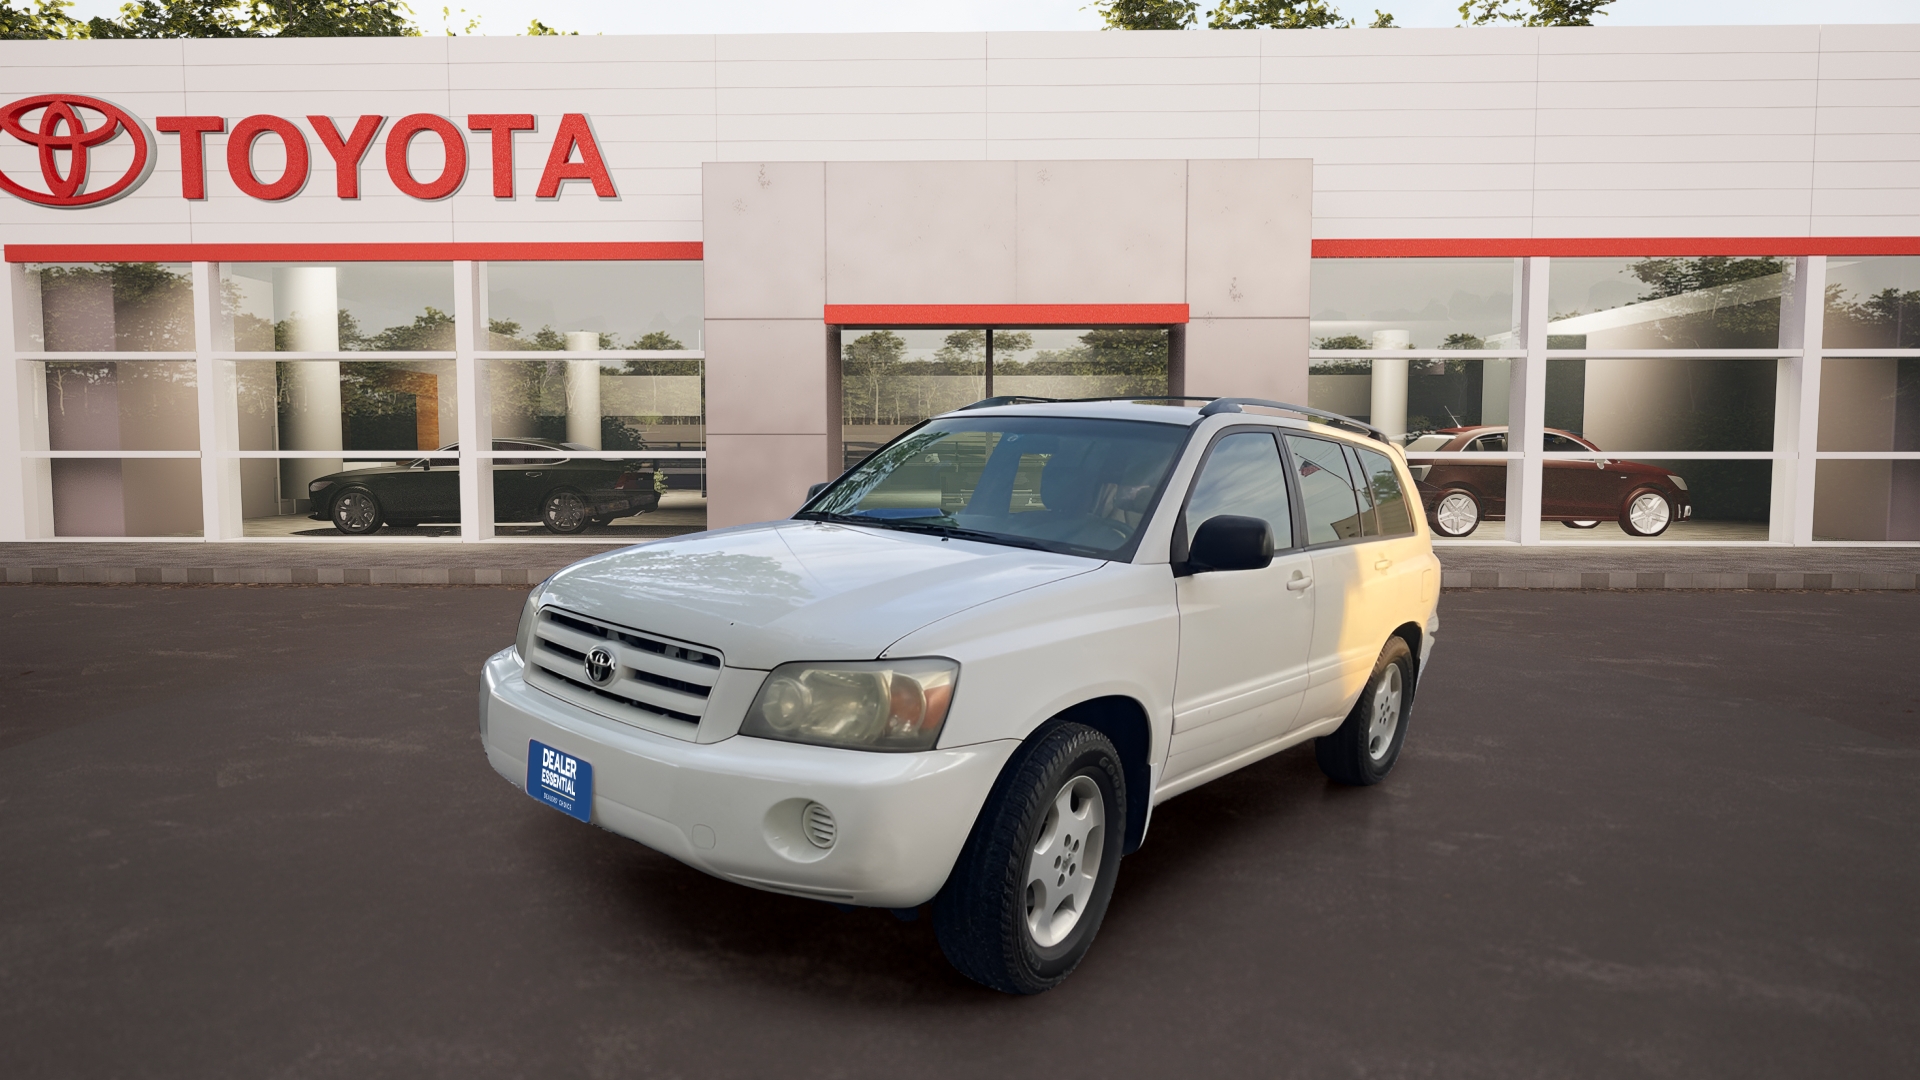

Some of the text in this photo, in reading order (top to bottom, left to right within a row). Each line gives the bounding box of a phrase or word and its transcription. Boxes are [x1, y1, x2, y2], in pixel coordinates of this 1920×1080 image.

[156, 113, 620, 201] TOYOTA
[542, 747, 577, 780] DEALER
[541, 768, 576, 796] ESSENTIAL
